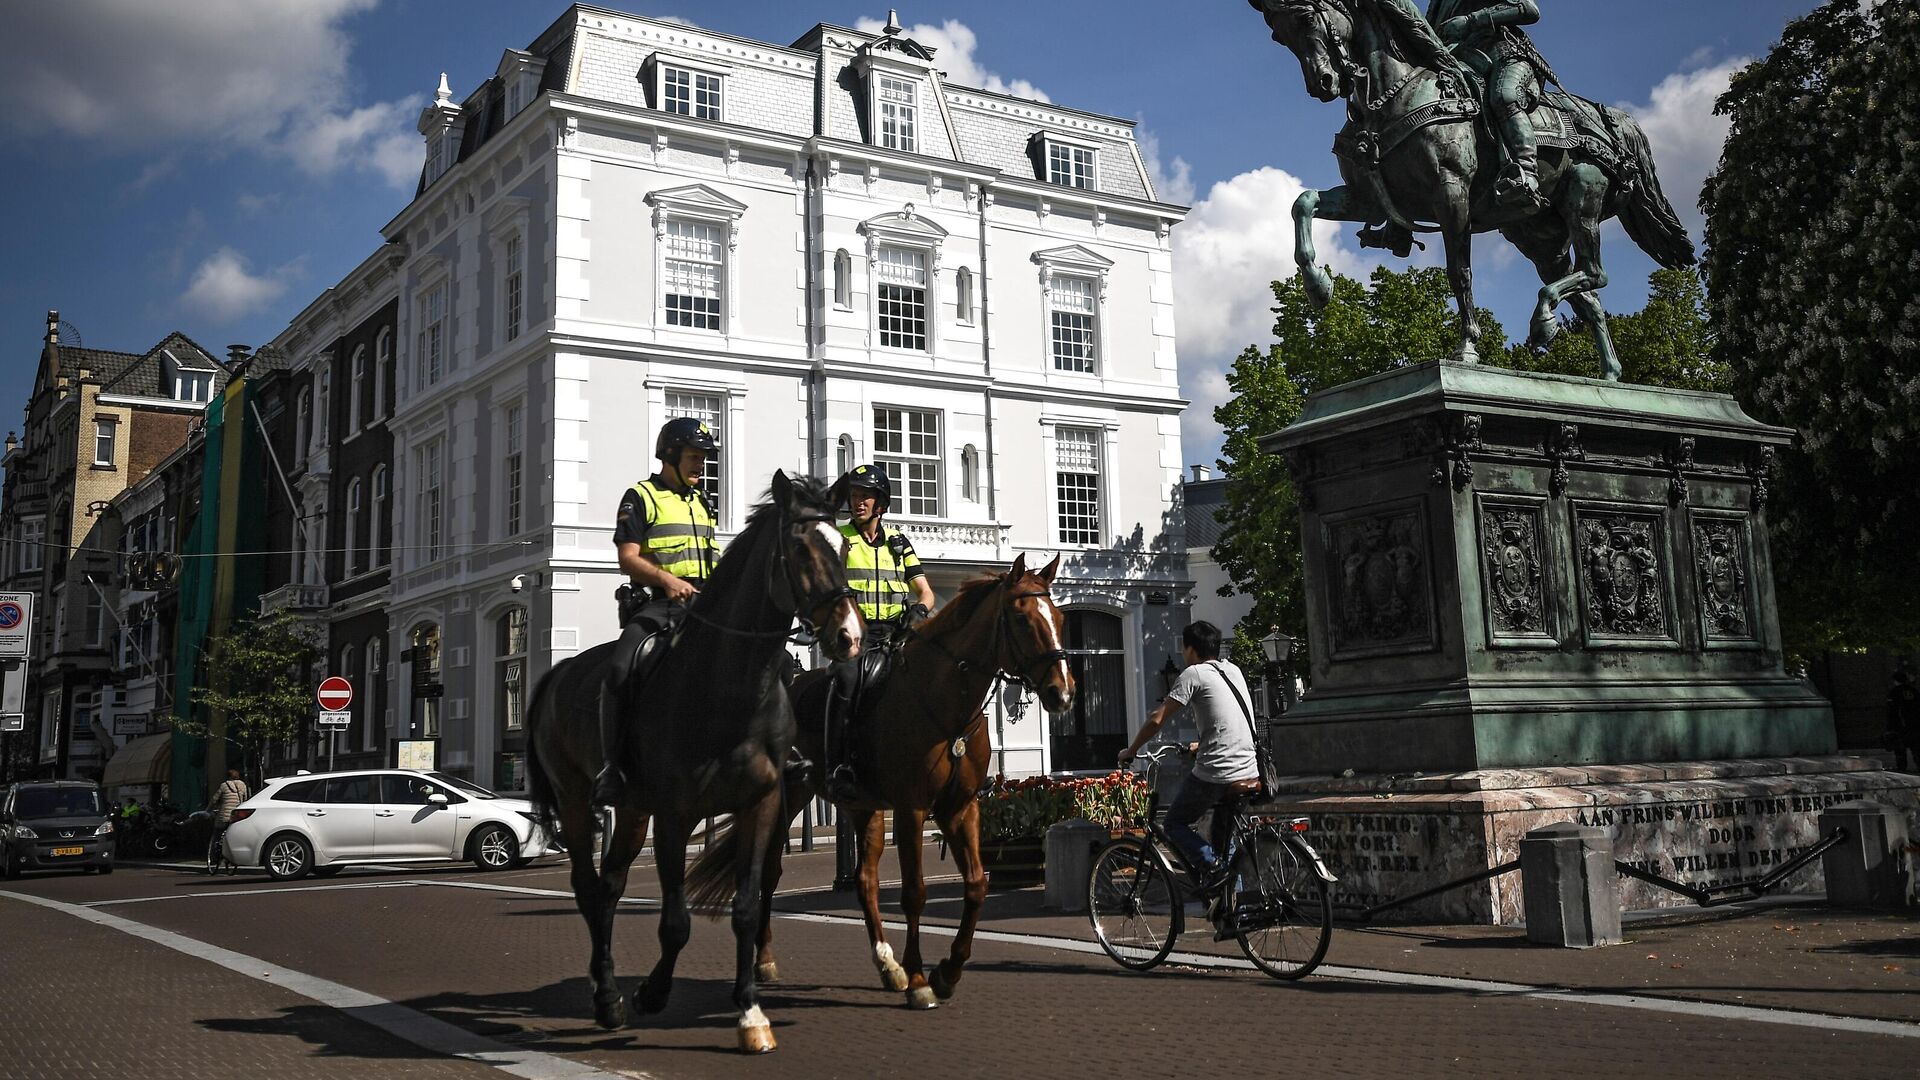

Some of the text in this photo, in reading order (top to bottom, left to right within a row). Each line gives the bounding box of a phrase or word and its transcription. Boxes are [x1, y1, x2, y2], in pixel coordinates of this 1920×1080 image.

[1578, 809, 1614, 827] AAN
[1621, 804, 1676, 825] PRINS
[1679, 800, 1747, 822] WILLEM
[1752, 798, 1787, 816] DEN
[1708, 825, 1756, 844] DOOR
[1747, 849, 1783, 867] DEN
